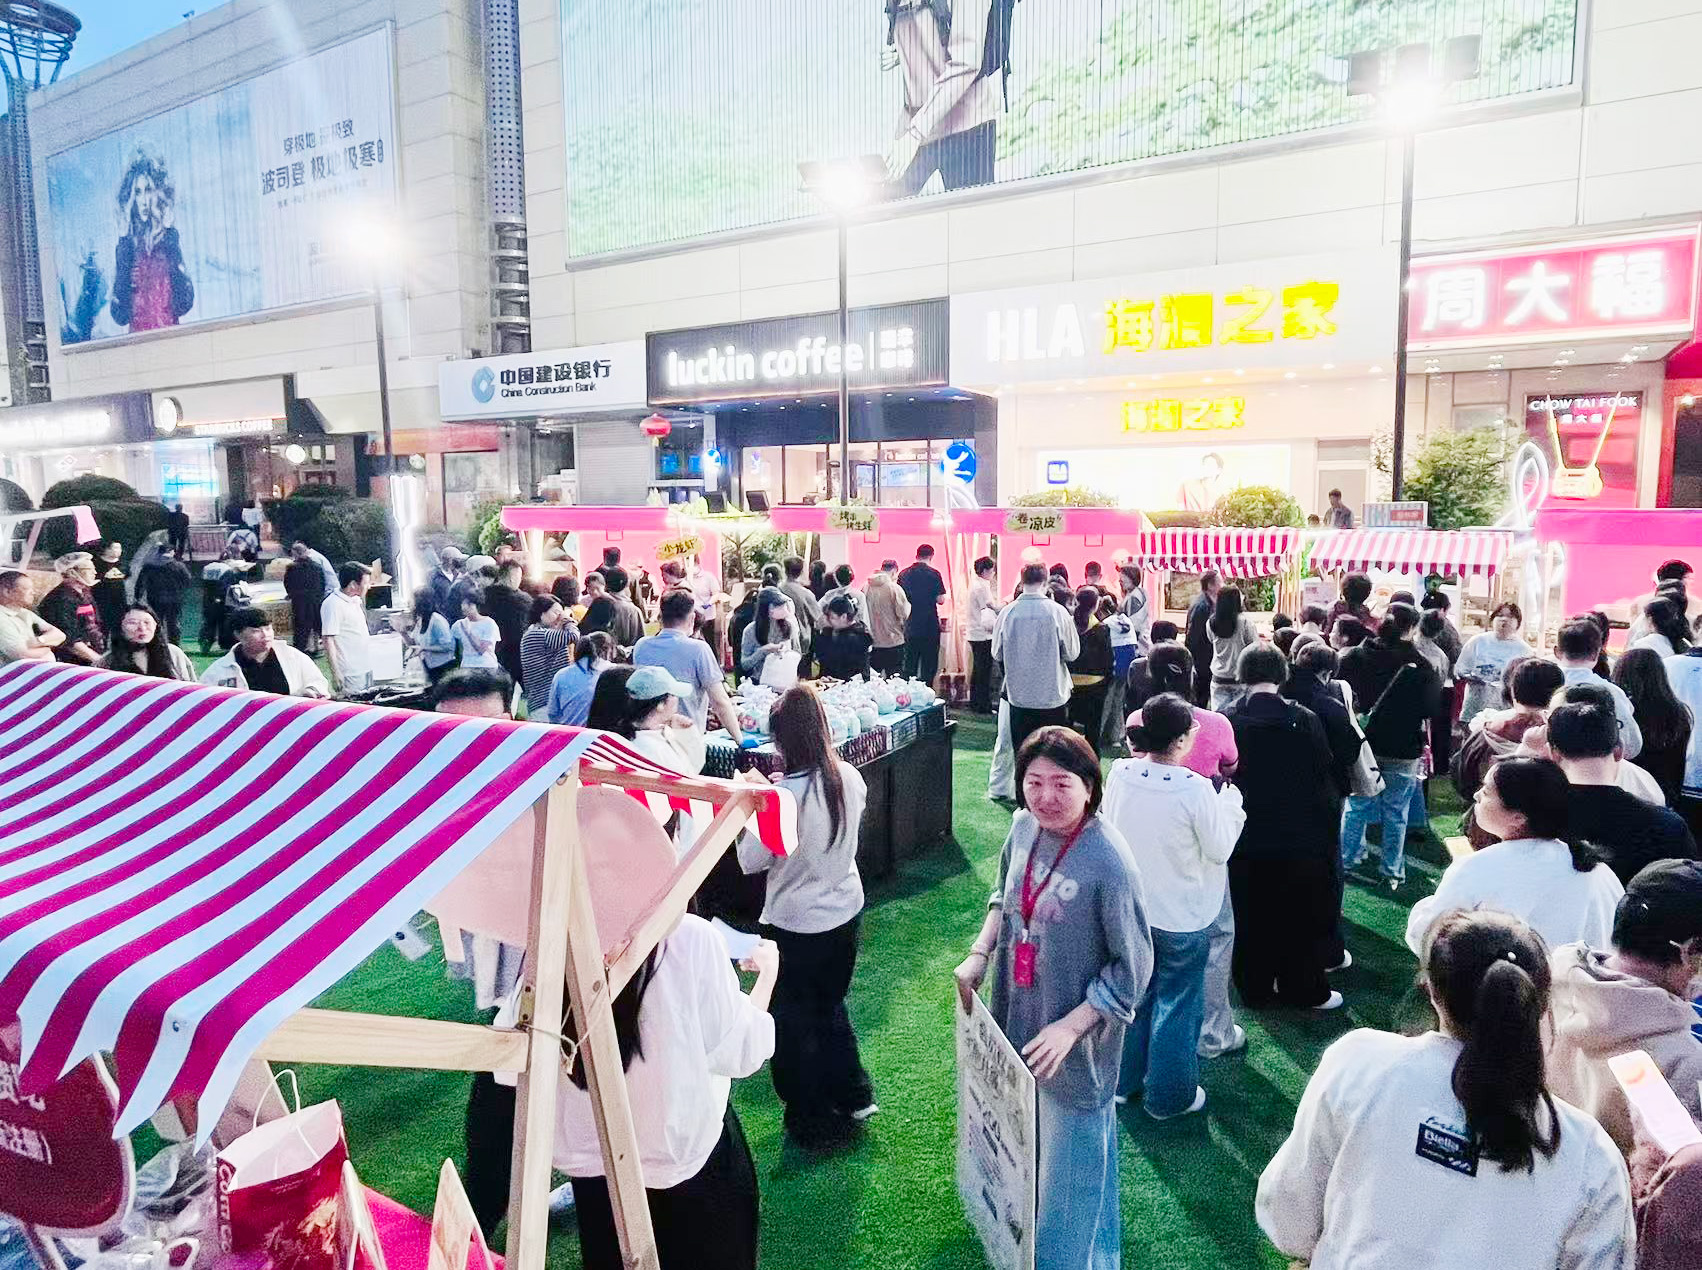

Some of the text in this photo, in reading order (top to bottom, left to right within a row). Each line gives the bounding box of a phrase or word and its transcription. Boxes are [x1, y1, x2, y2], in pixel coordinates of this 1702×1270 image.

[261, 161, 306, 195] 波司登
[1420, 250, 1665, 332] 周大福
[986, 302, 1086, 363] HLA
[1103, 279, 1340, 354] 海澜之家
[500, 359, 612, 386] 中国建设银行
[667, 336, 864, 387] luckin coffee
[501, 381, 598, 398] China Construction Bank
[1528, 396, 1638, 411] CHOW TAI FOOK
